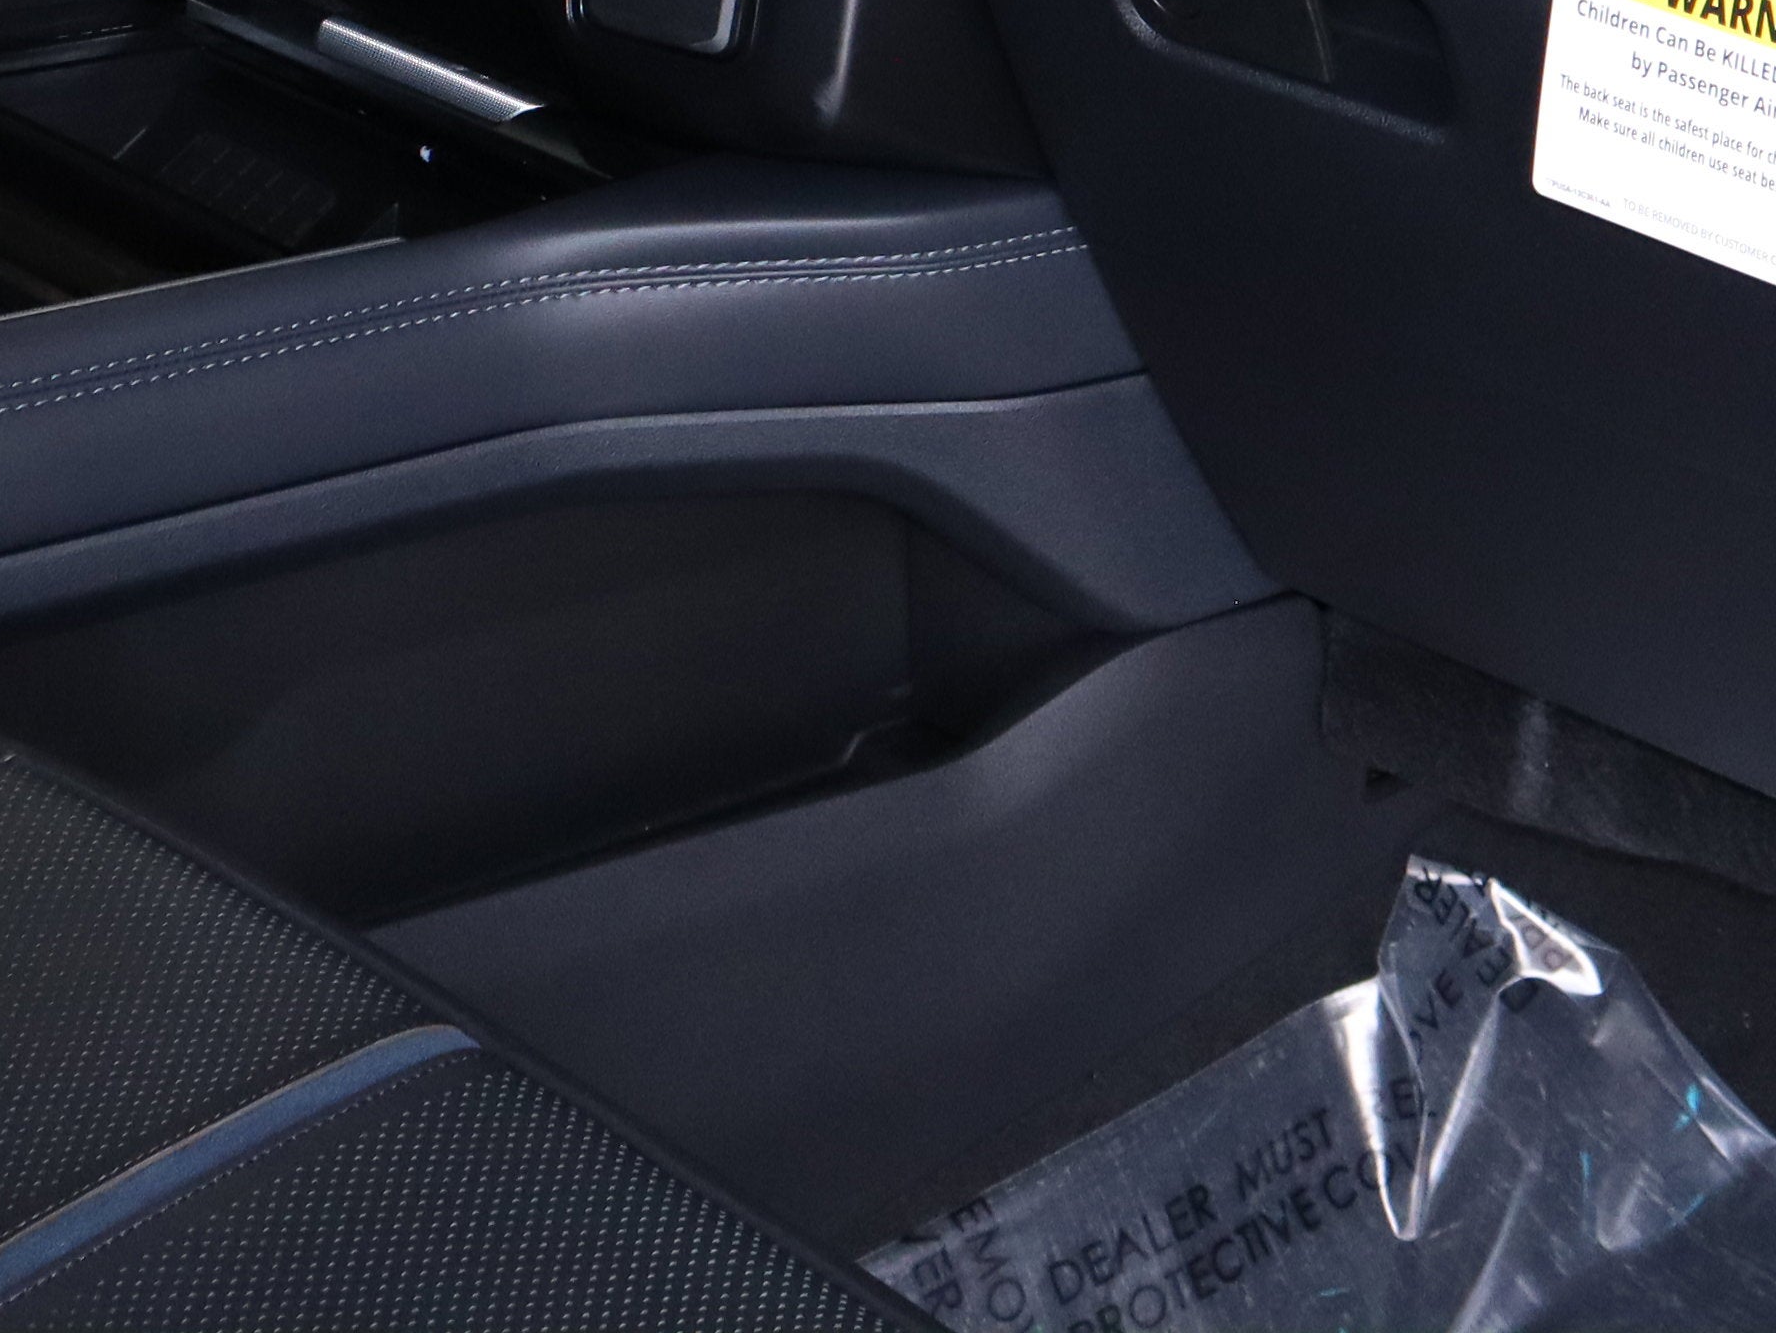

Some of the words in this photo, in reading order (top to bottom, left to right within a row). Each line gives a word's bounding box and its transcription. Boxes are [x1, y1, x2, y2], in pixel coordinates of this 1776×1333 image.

[1631, 51, 1652, 78] by
[1657, 61, 1750, 108] Passenger
[1656, 26, 1689, 52] Can
[1694, 39, 1717, 62] Be
[1561, 73, 1580, 94] The
[1583, 81, 1610, 105] back
[1612, 95, 1636, 115] seat
[1639, 102, 1649, 119] is
[1652, 107, 1672, 127] the
[1674, 117, 1709, 141] safest
[1712, 130, 1743, 153] place
[1746, 140, 1764, 160] for
[1578, 106, 1611, 131] Make
[1613, 121, 1638, 141] sure
[1640, 130, 1655, 147] all
[1658, 136, 1705, 166] children
[1708, 156, 1729, 175] use
[1732, 164, 1757, 185] seat
[1623, 197, 1636, 212] TO
[1638, 204, 1650, 218] BE
[1652, 209, 1699, 236] REMOVED
[1700, 228, 1714, 241] BY
[1714, 233, 1768, 262] CUSTOMER
[1046, 1184, 1218, 1306] DEALER
[1233, 1109, 1333, 1202] MUST
